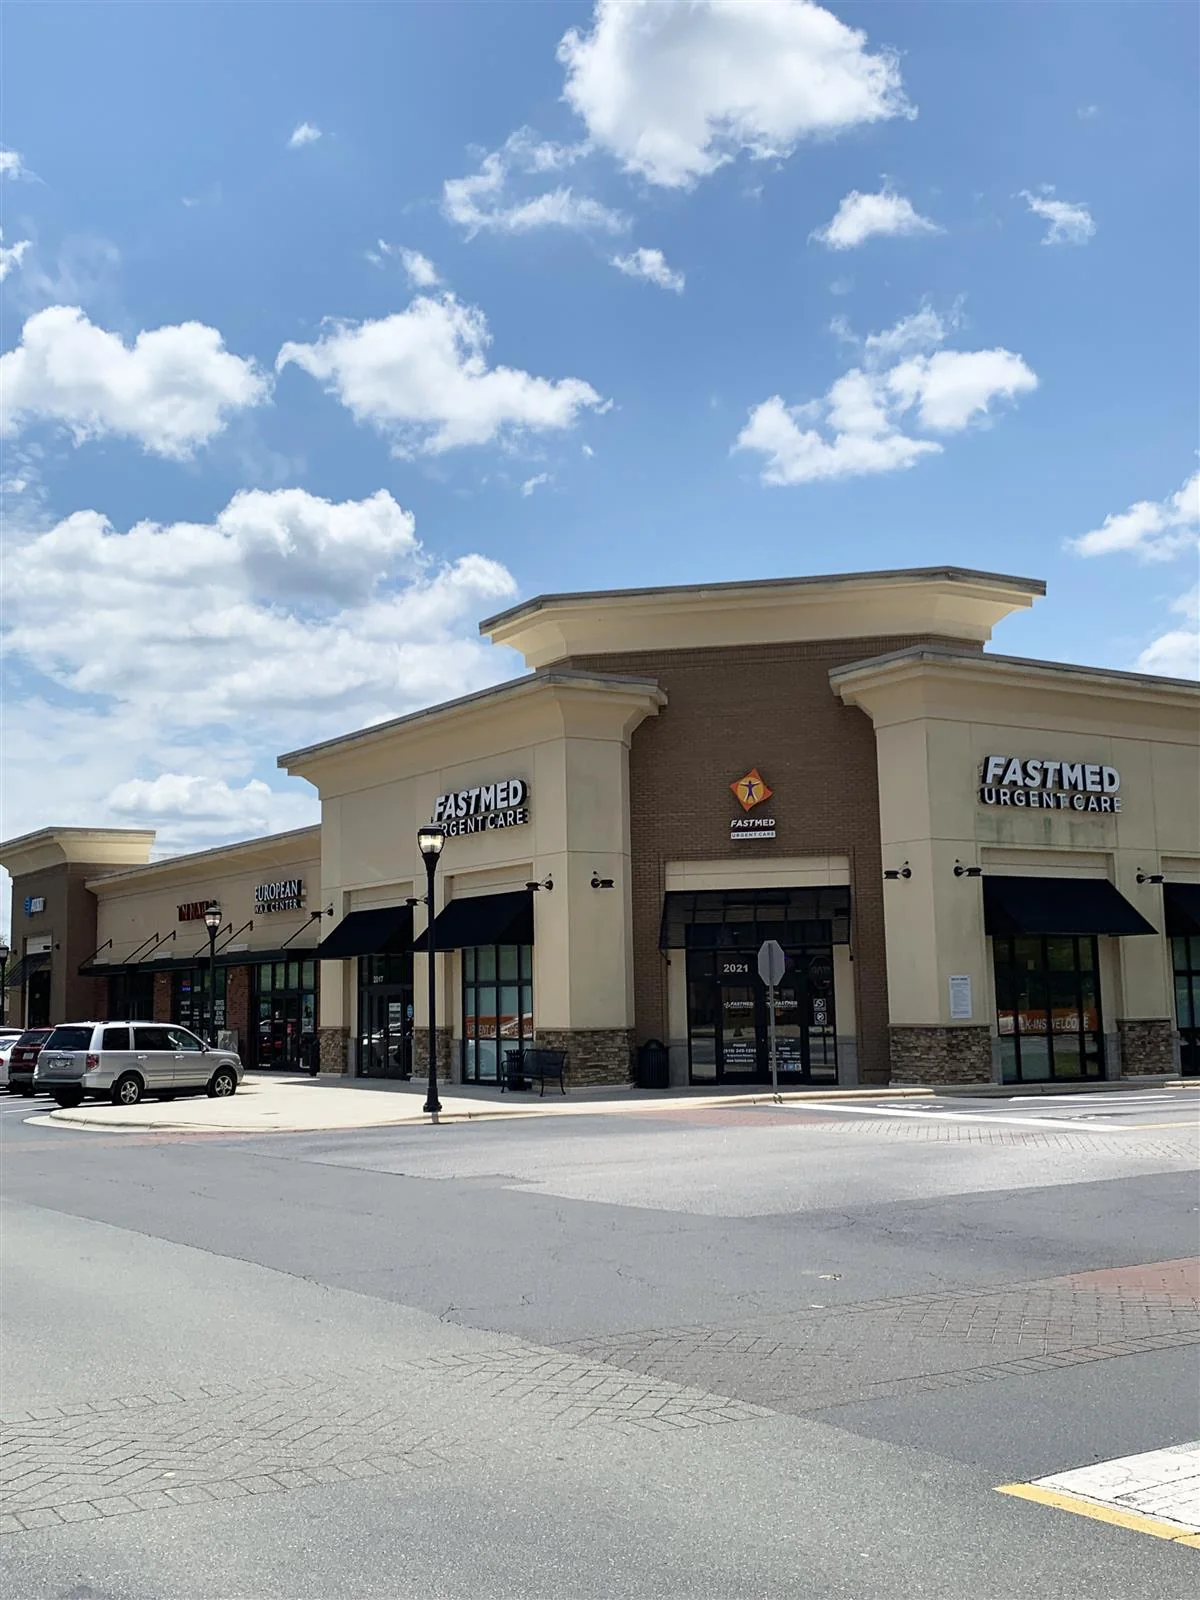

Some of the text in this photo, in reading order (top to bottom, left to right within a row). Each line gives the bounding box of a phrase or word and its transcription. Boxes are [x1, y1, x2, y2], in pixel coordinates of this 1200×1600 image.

[985, 755, 1121, 794] FASTMED
[433, 779, 523, 822] FASTMED
[983, 787, 1122, 813] URGENT CARE
[440, 808, 524, 837] RGENT CARE
[730, 818, 776, 828] FASTMED
[254, 880, 298, 902] EUROPEAN
[270, 899, 298, 912] CENTER
[723, 963, 749, 973] 2021
